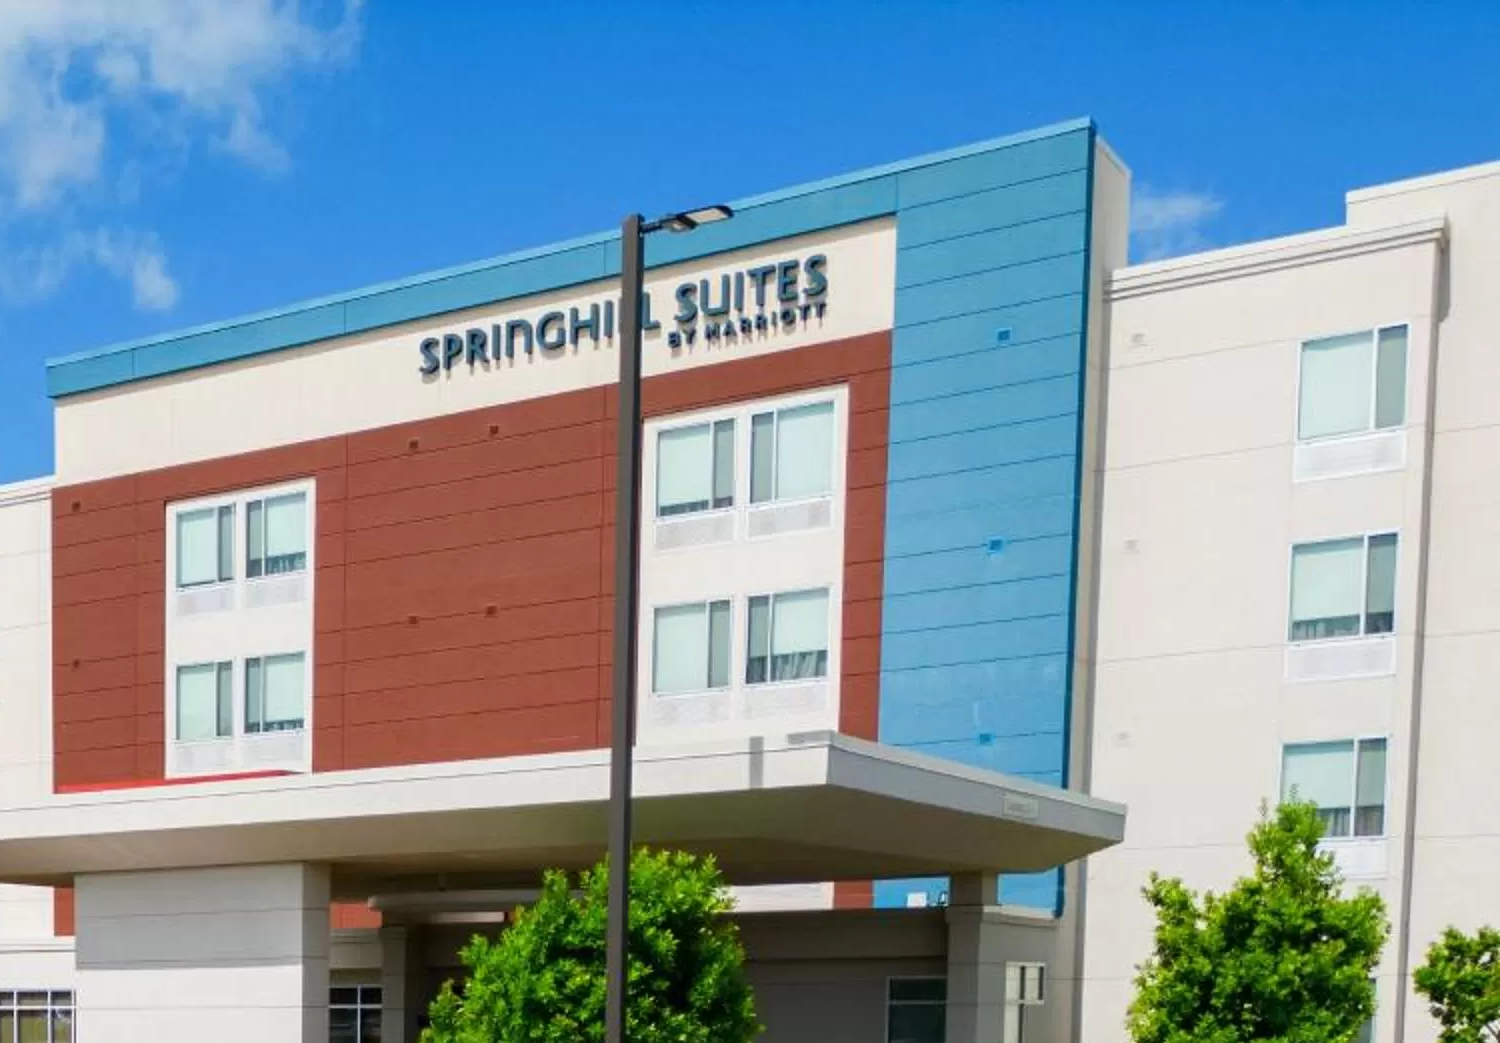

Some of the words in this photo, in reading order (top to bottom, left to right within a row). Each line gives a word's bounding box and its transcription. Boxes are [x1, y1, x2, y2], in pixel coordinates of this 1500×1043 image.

[419, 292, 661, 374] SPRINGHIL
[674, 253, 828, 322] SUITES
[668, 329, 697, 349] BY
[705, 302, 827, 342] MARRIOTT
